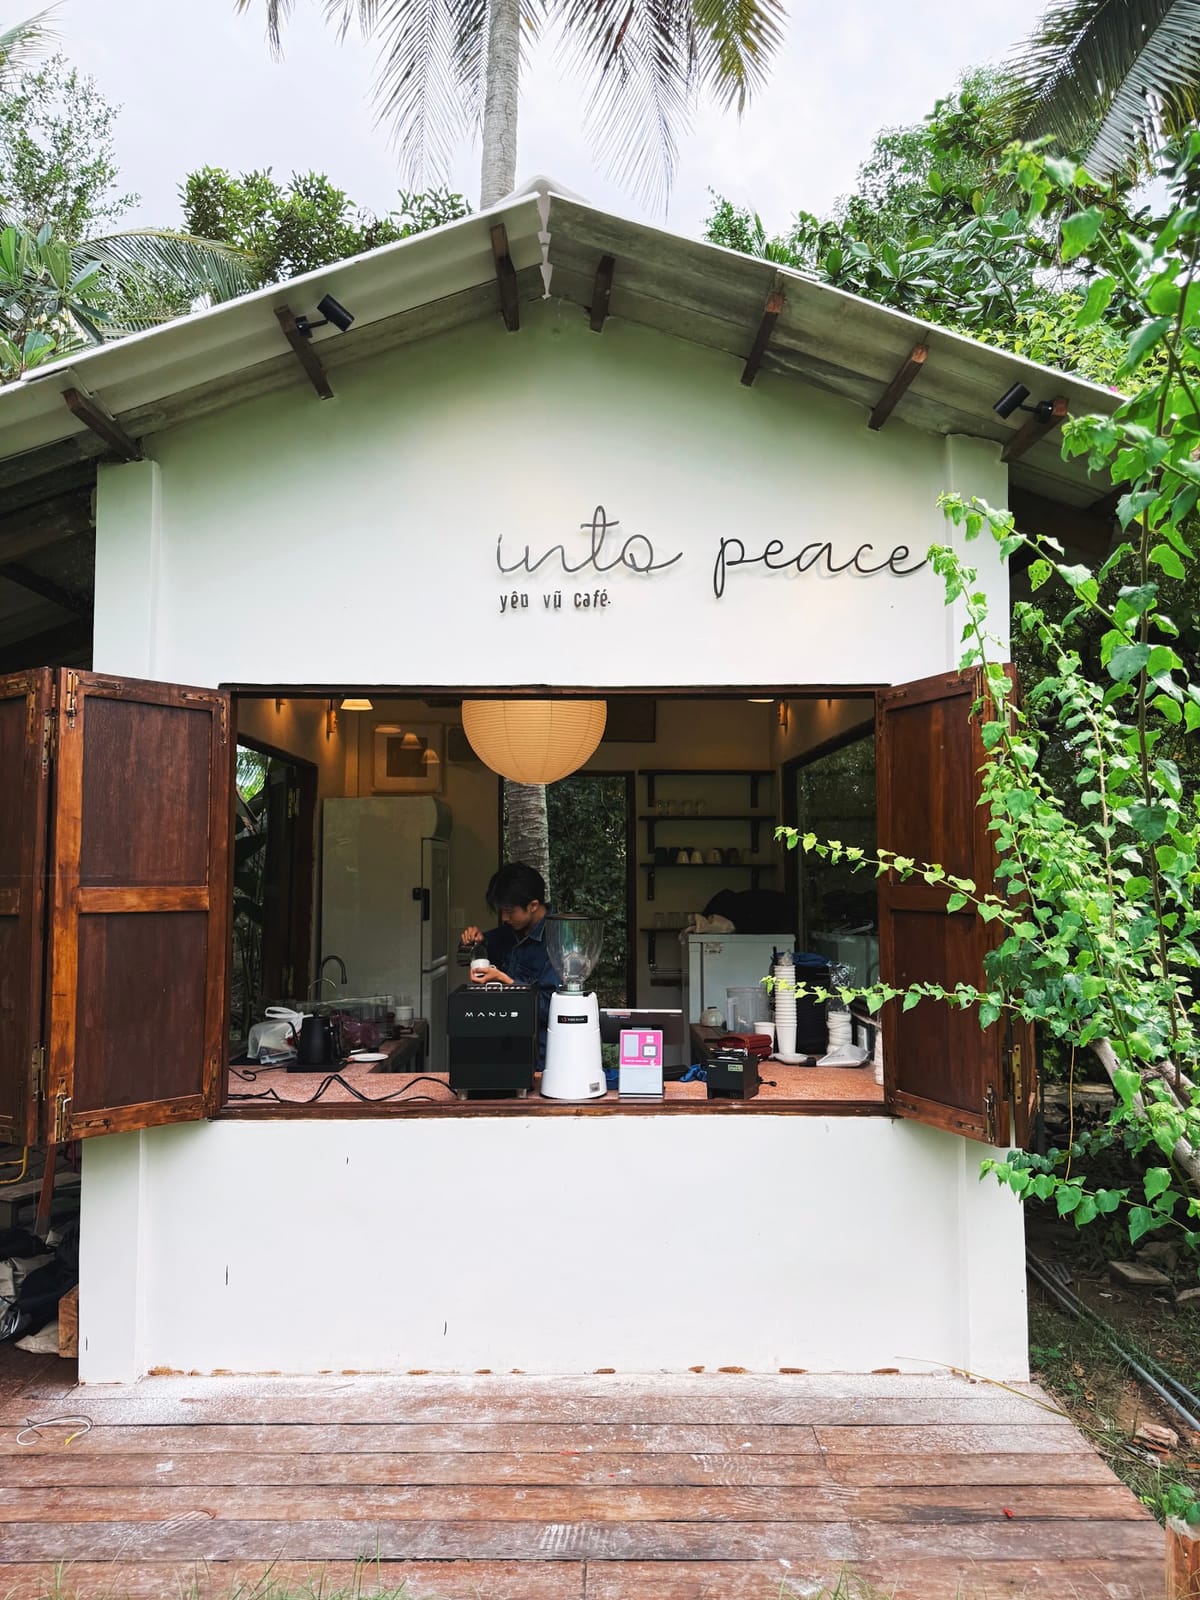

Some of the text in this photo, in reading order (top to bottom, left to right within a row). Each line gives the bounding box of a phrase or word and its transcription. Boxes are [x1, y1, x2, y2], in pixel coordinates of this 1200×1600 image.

[712, 536, 928, 600] peace
[499, 590, 529, 614] yên
[543, 590, 562, 609] vũ
